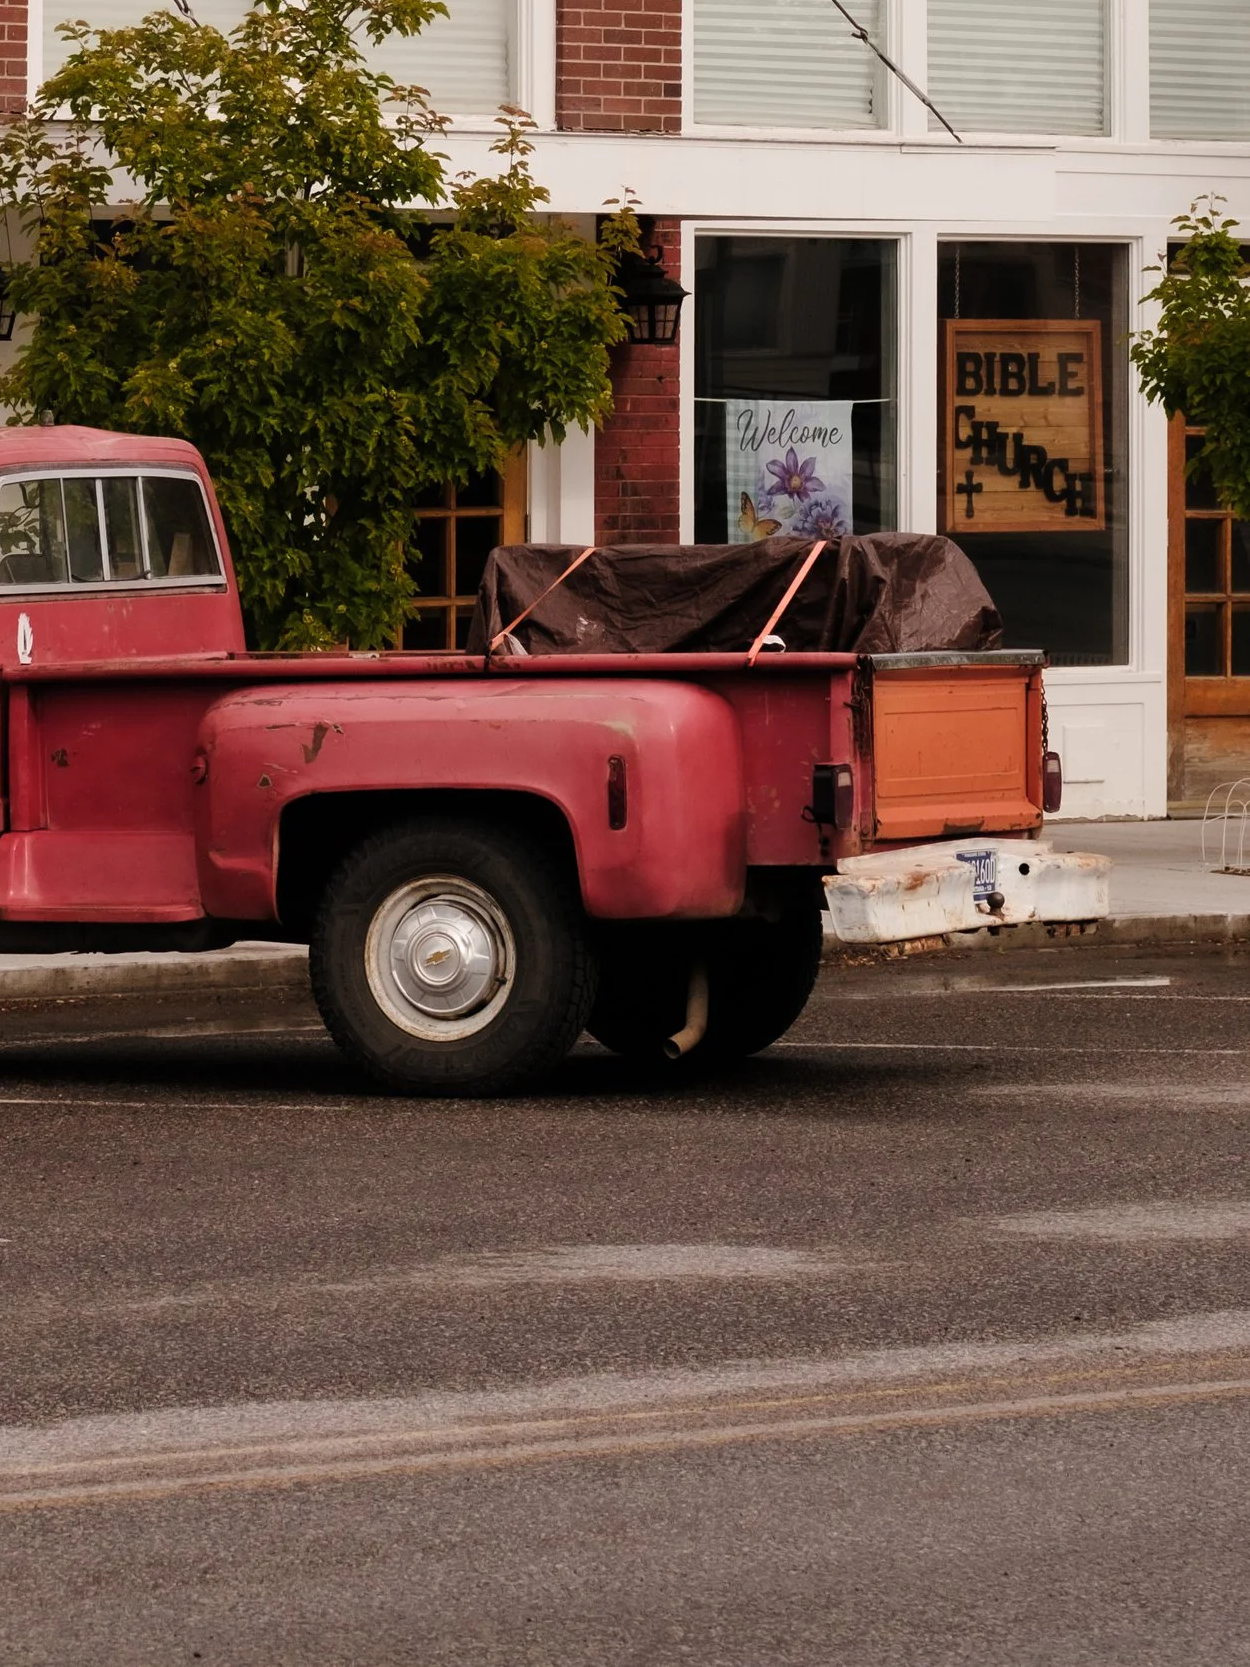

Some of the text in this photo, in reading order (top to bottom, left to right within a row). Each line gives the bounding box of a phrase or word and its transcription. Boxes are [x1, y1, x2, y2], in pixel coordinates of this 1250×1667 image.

[955, 352, 1085, 397] BIBLE
[736, 408, 844, 452] Welcome
[955, 405, 1097, 519] CHURCH
